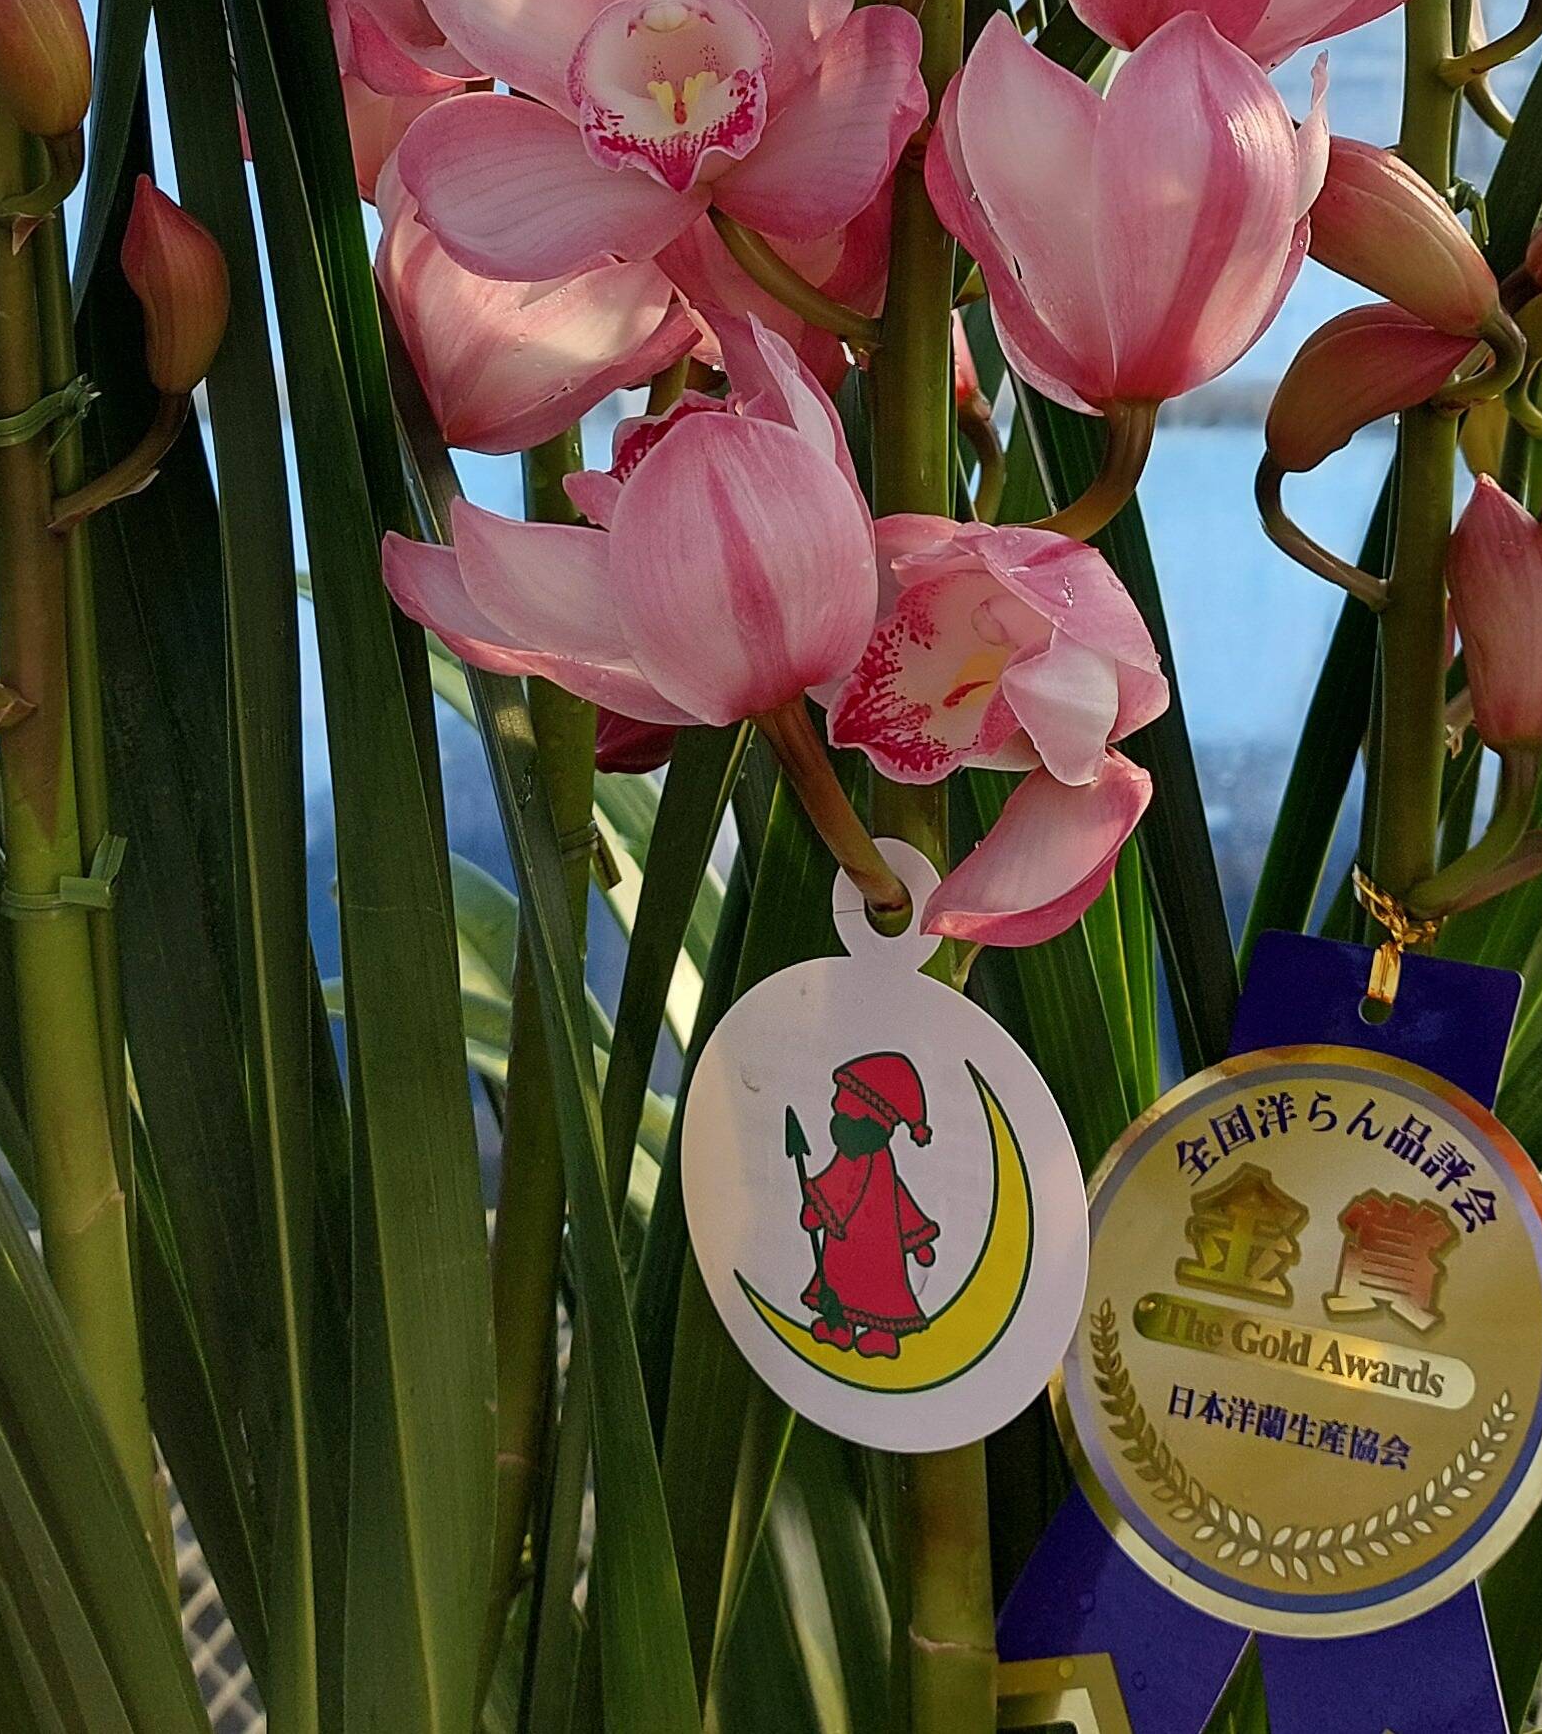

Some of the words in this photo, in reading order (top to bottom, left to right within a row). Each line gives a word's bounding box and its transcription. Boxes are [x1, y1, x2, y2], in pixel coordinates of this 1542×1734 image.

[1175, 1090, 1498, 1234] 全国洋らん品評会
[1161, 1302, 1225, 1347] The
[1230, 1319, 1312, 1368] Gold
[1315, 1339, 1446, 1399] Awards
[1167, 1382, 1412, 1471] 日本洋蘭生産協会
